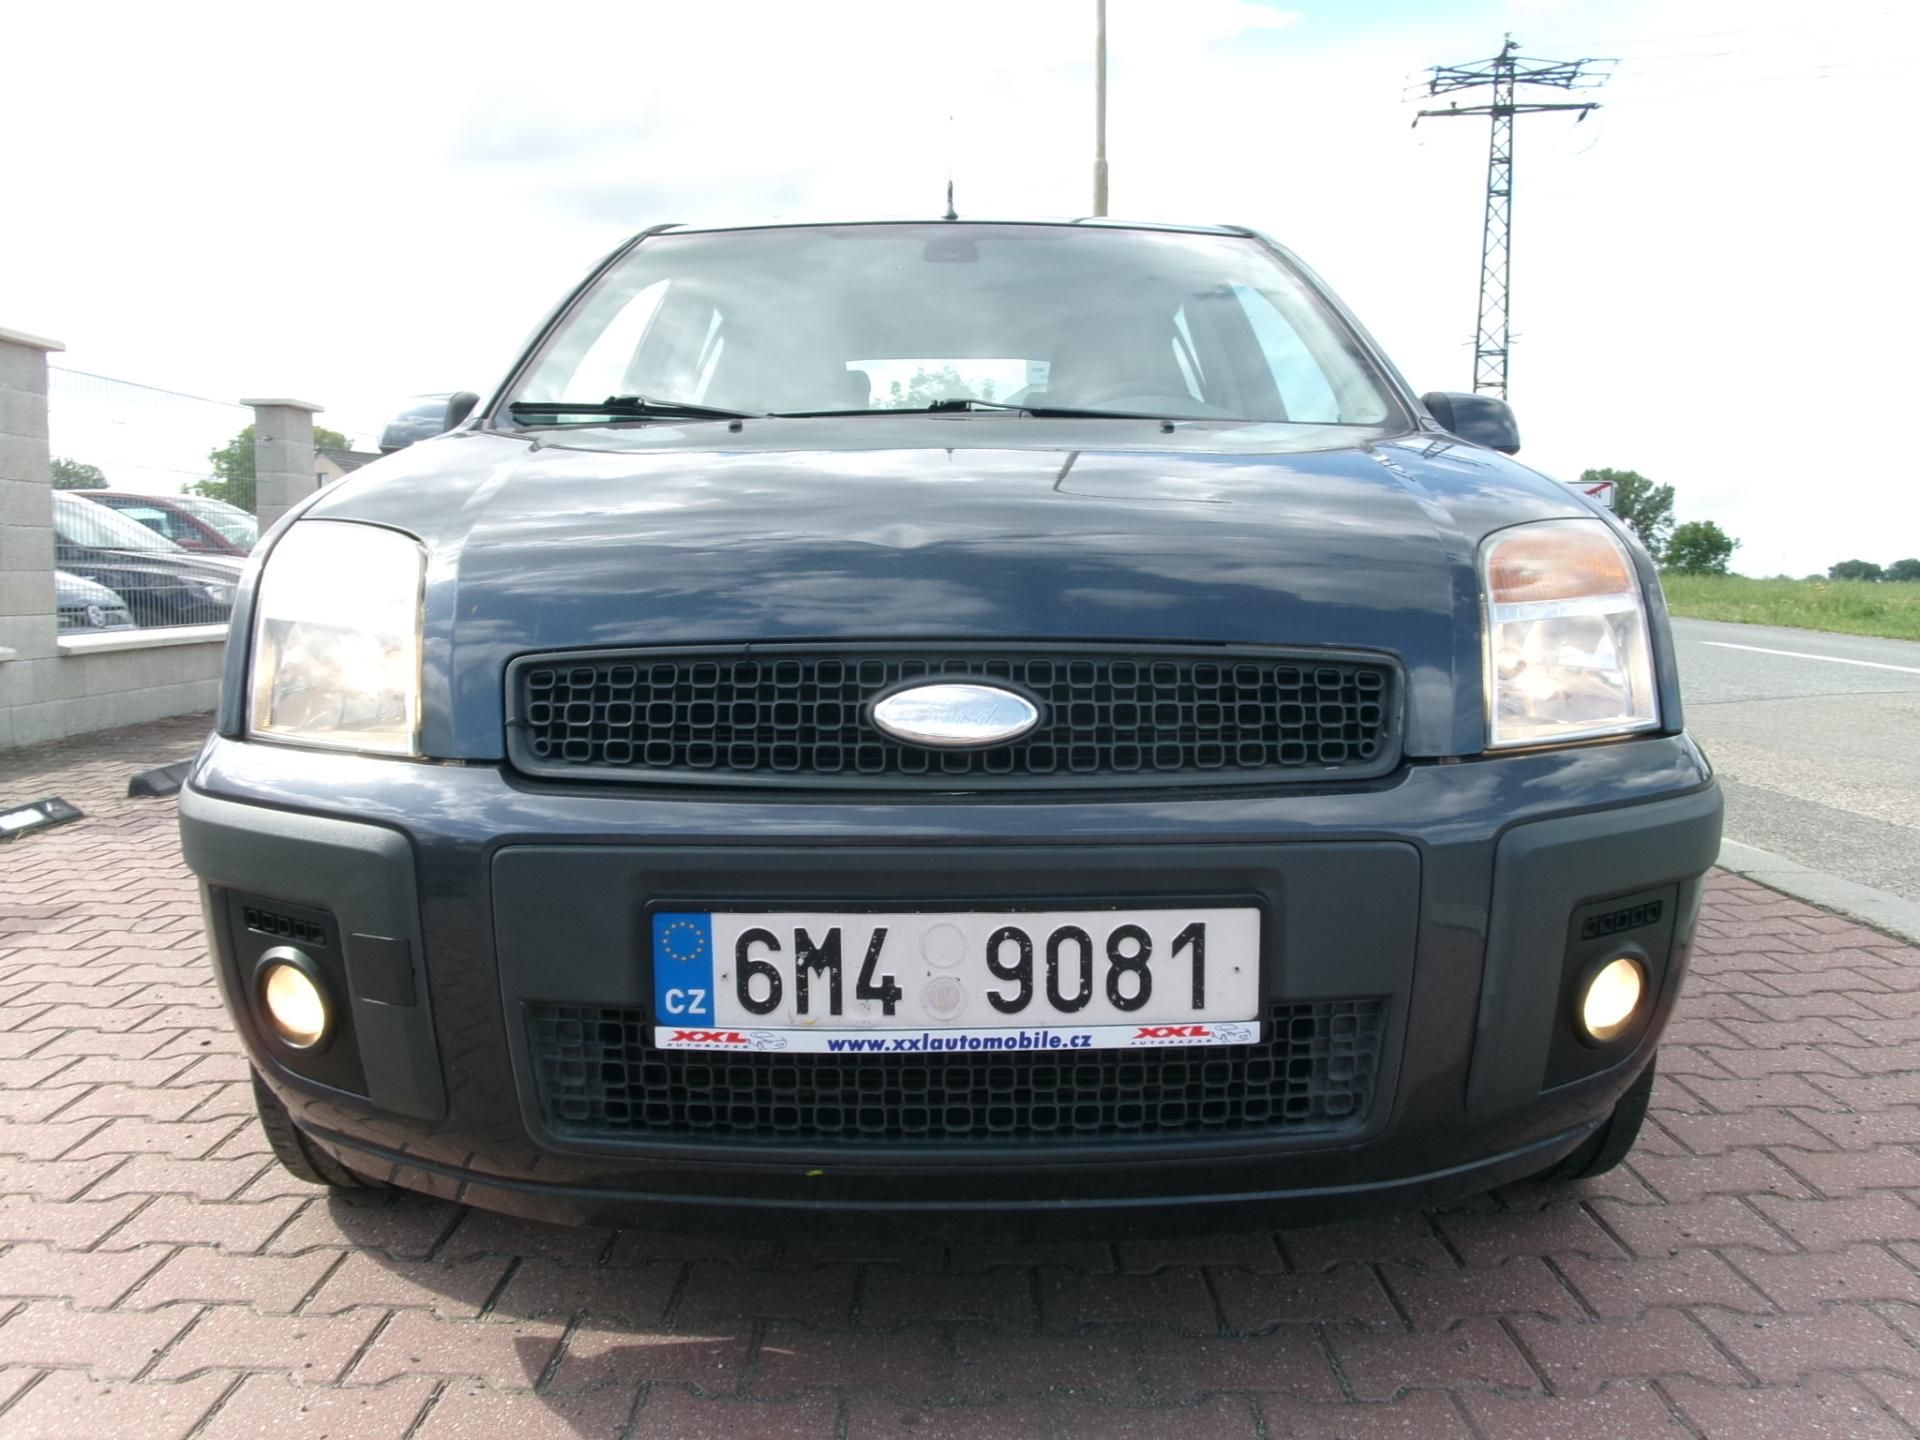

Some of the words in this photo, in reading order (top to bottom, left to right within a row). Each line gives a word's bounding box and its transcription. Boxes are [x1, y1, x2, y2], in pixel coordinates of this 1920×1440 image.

[735, 927, 902, 1016] 6M4
[986, 922, 1206, 1014] 9081
[665, 989, 706, 1014] CZ
[669, 1030, 748, 1044] XXL
[827, 1031, 1092, 1051] www.xxlautomobile.cz
[1131, 1025, 1211, 1039] XXL
